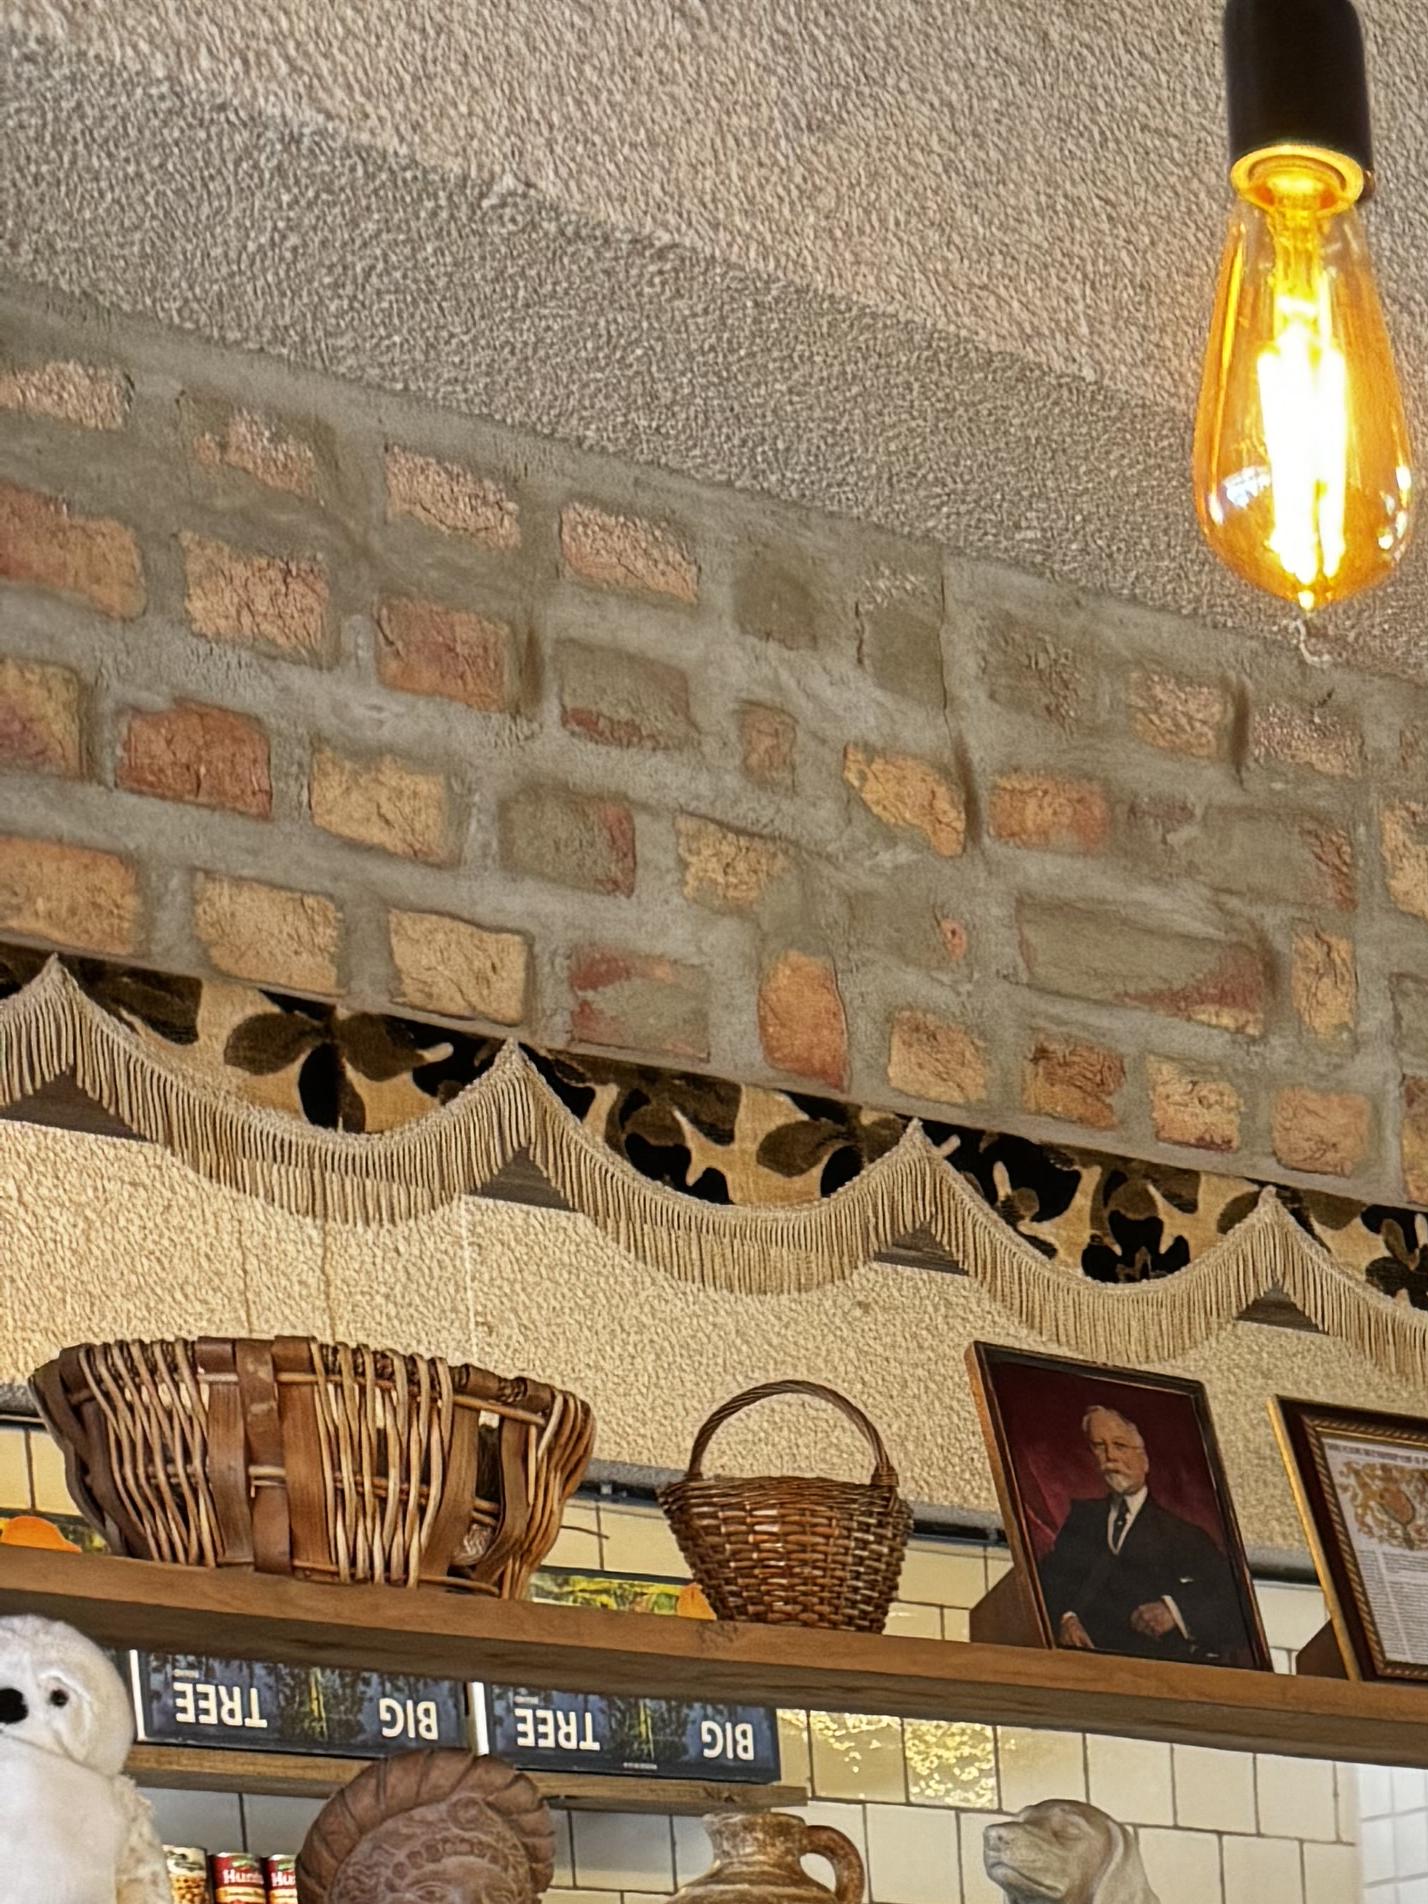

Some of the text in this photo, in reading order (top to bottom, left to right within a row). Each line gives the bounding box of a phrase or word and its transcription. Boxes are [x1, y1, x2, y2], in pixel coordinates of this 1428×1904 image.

[173, 1682, 438, 1741] BIG TREE
[514, 1706, 754, 1762] BIG TREE
